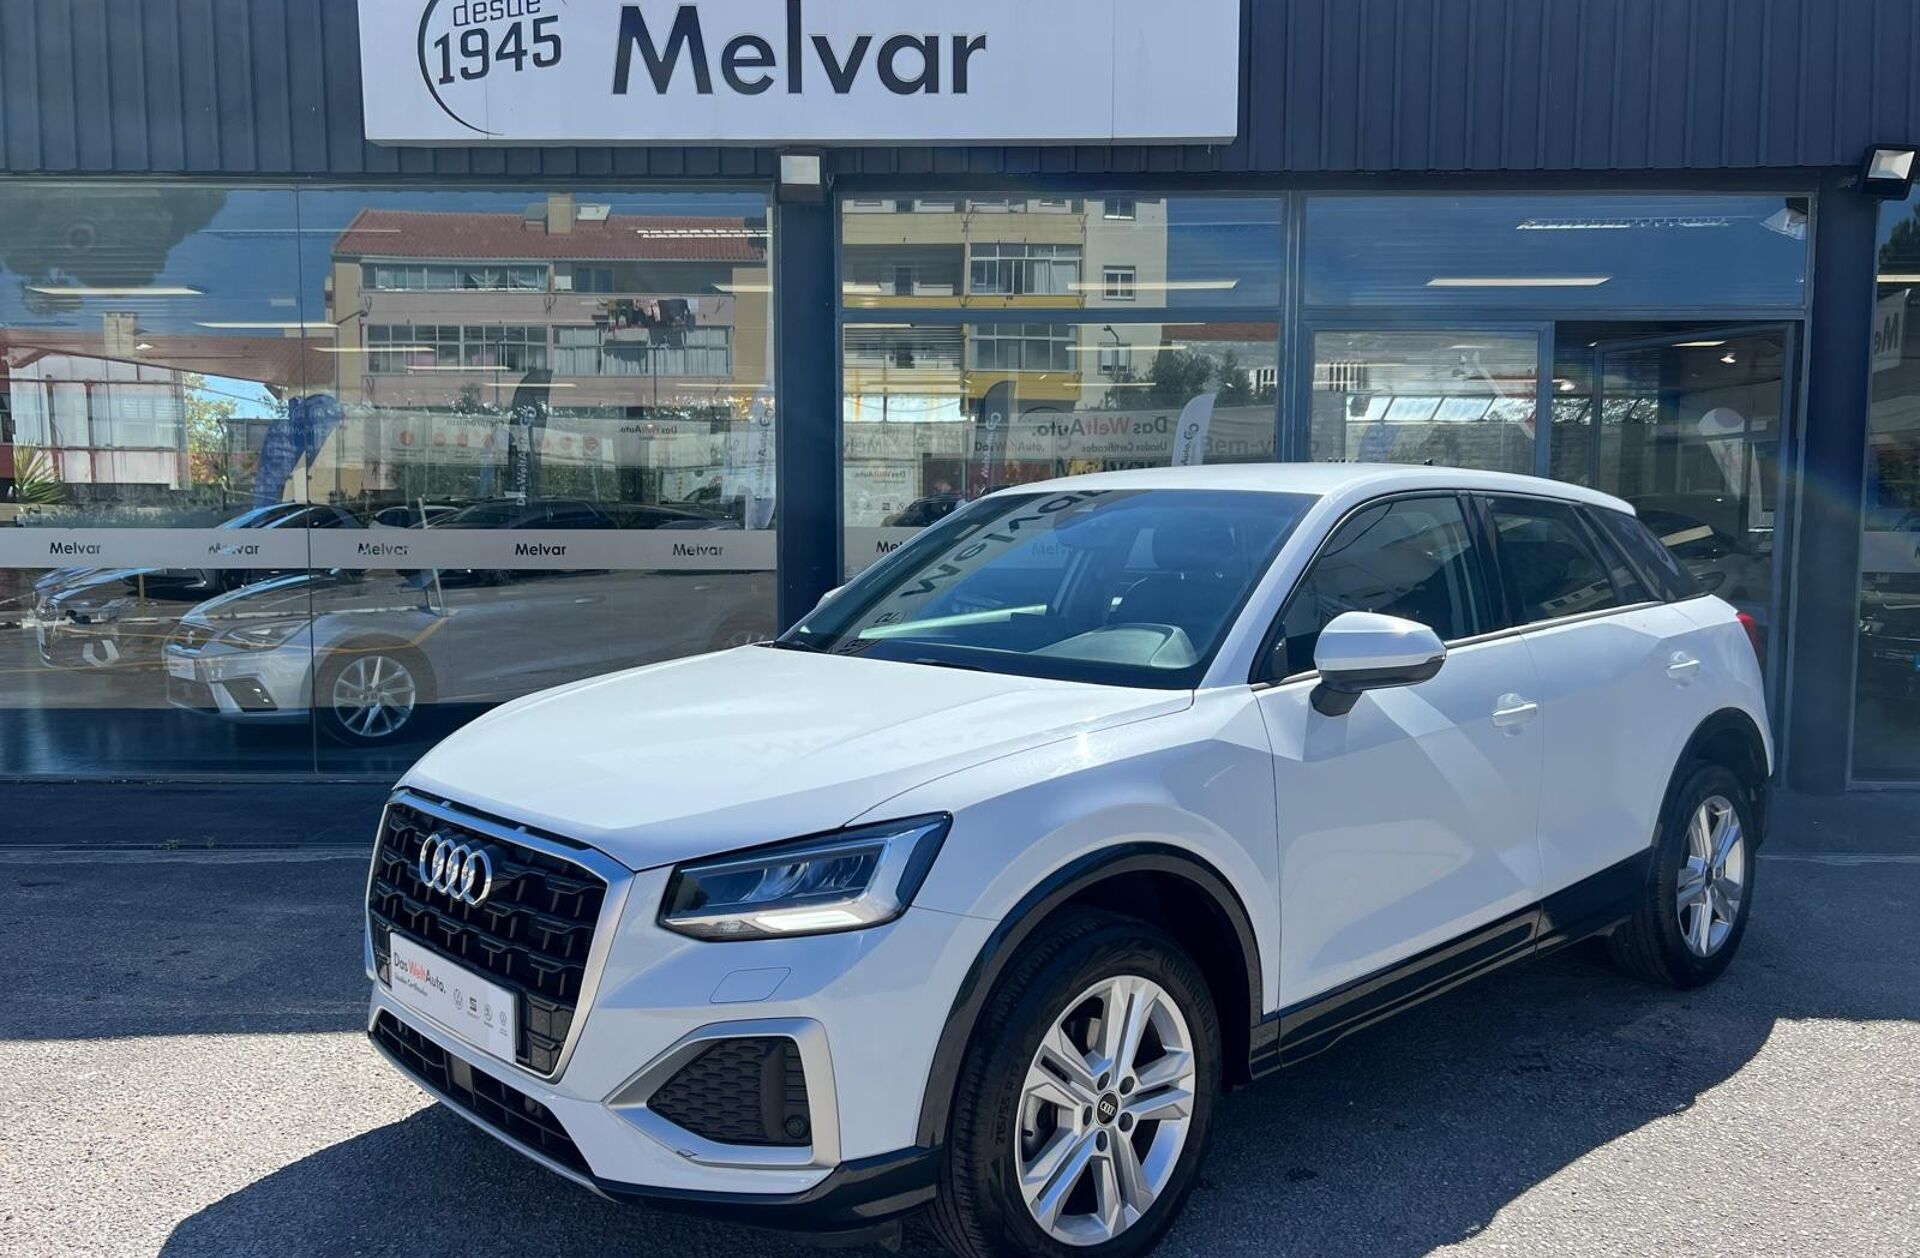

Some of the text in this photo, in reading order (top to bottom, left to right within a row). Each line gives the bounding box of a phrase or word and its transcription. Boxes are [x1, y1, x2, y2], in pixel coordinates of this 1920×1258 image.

[434, 15, 562, 85] 1945
[612, 0, 988, 95] Melvar
[49, 541, 102, 555] Melvar
[515, 543, 567, 556] Melvar
[672, 543, 724, 556] Melvar
